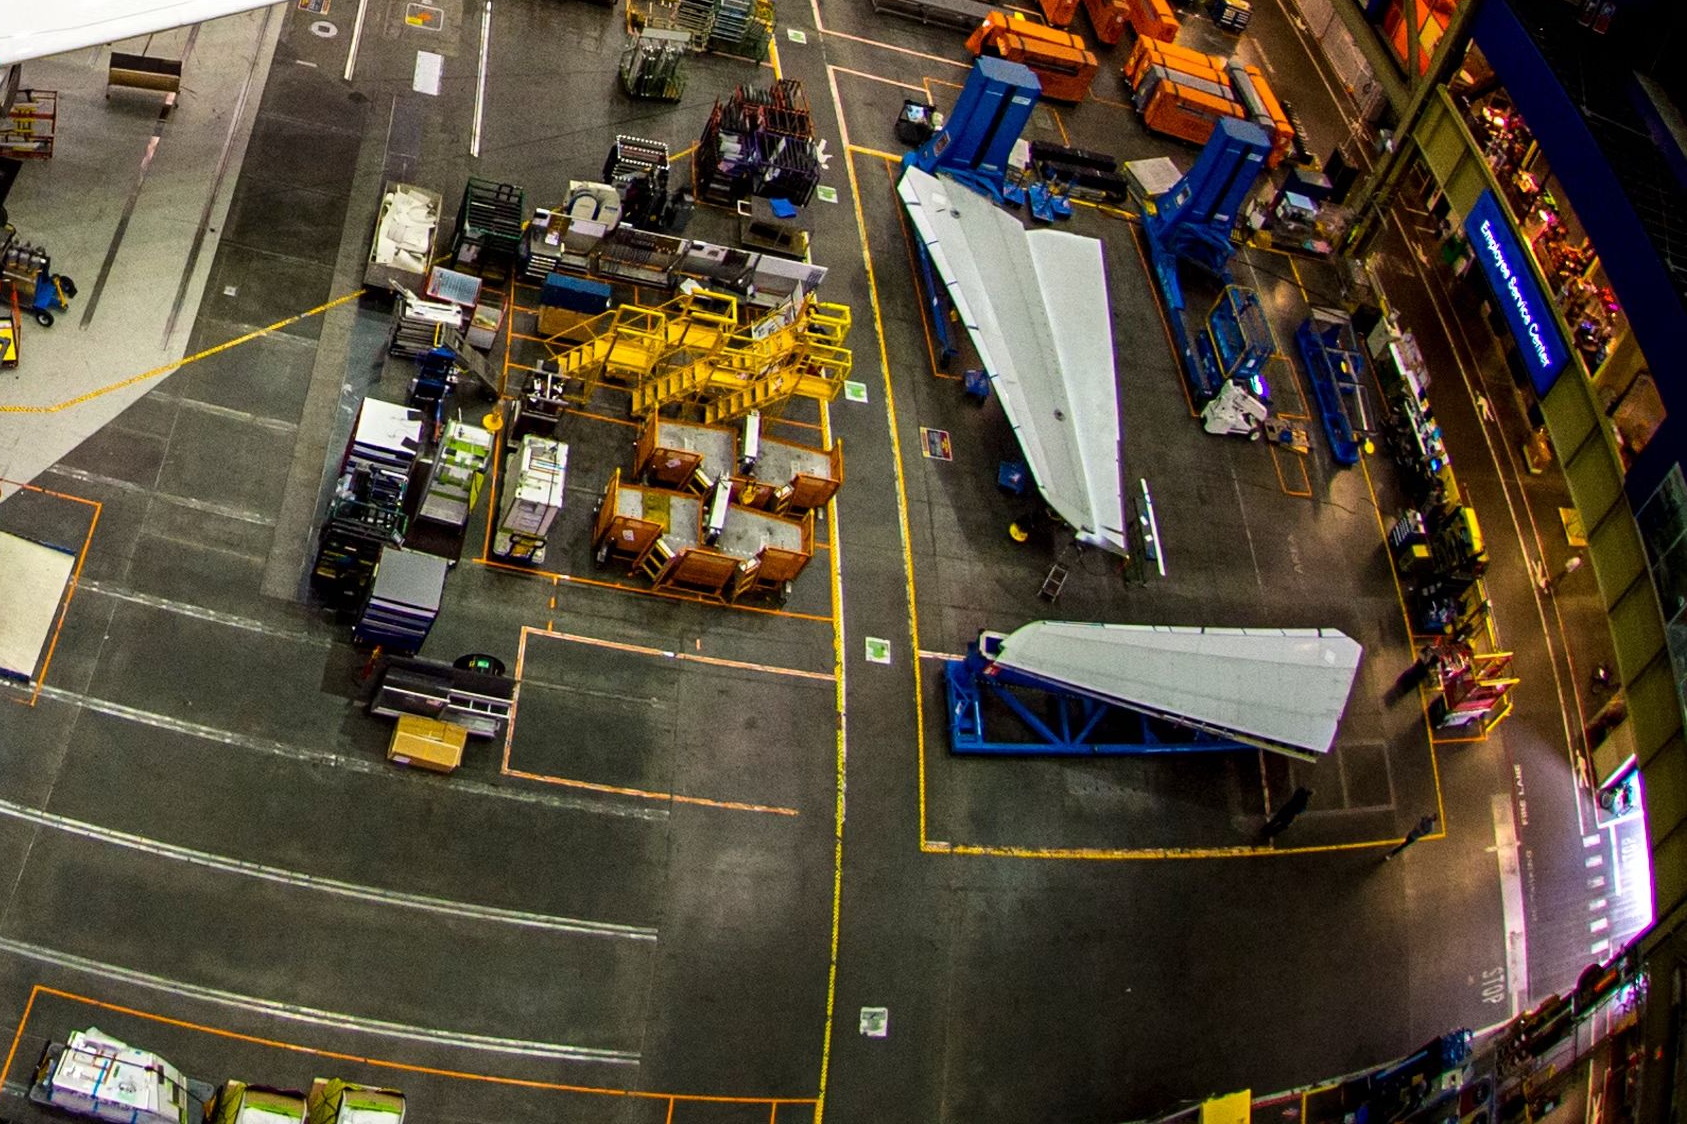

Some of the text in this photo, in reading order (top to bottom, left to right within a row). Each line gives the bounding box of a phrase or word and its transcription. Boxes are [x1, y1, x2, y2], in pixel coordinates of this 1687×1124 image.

[1480, 219, 1552, 369] Employee Service Center
[1481, 966, 1505, 1005] STOP
